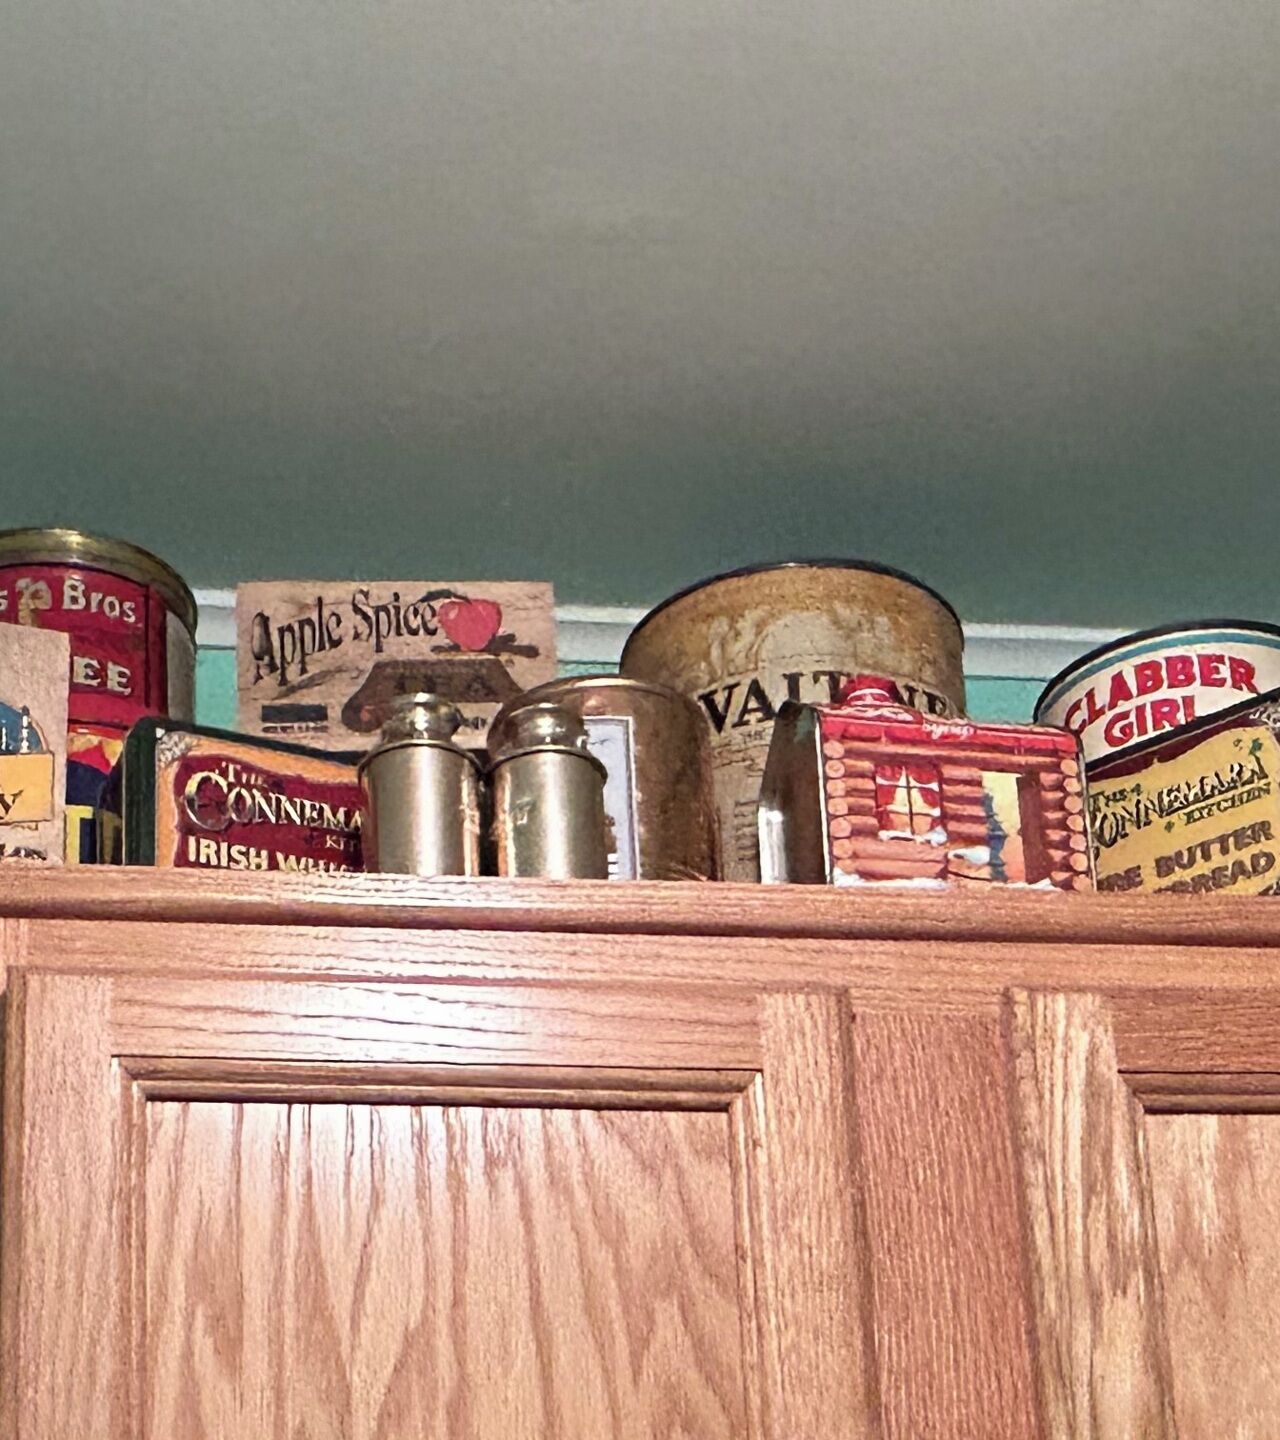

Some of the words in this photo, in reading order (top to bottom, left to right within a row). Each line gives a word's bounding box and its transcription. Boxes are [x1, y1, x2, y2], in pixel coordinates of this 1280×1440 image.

[251, 595, 344, 687] Apple
[351, 588, 439, 653] Spice
[1065, 653, 1262, 735] CLABBER
[187, 835, 269, 871] IRISH
[1155, 820, 1275, 878] BUTTER
